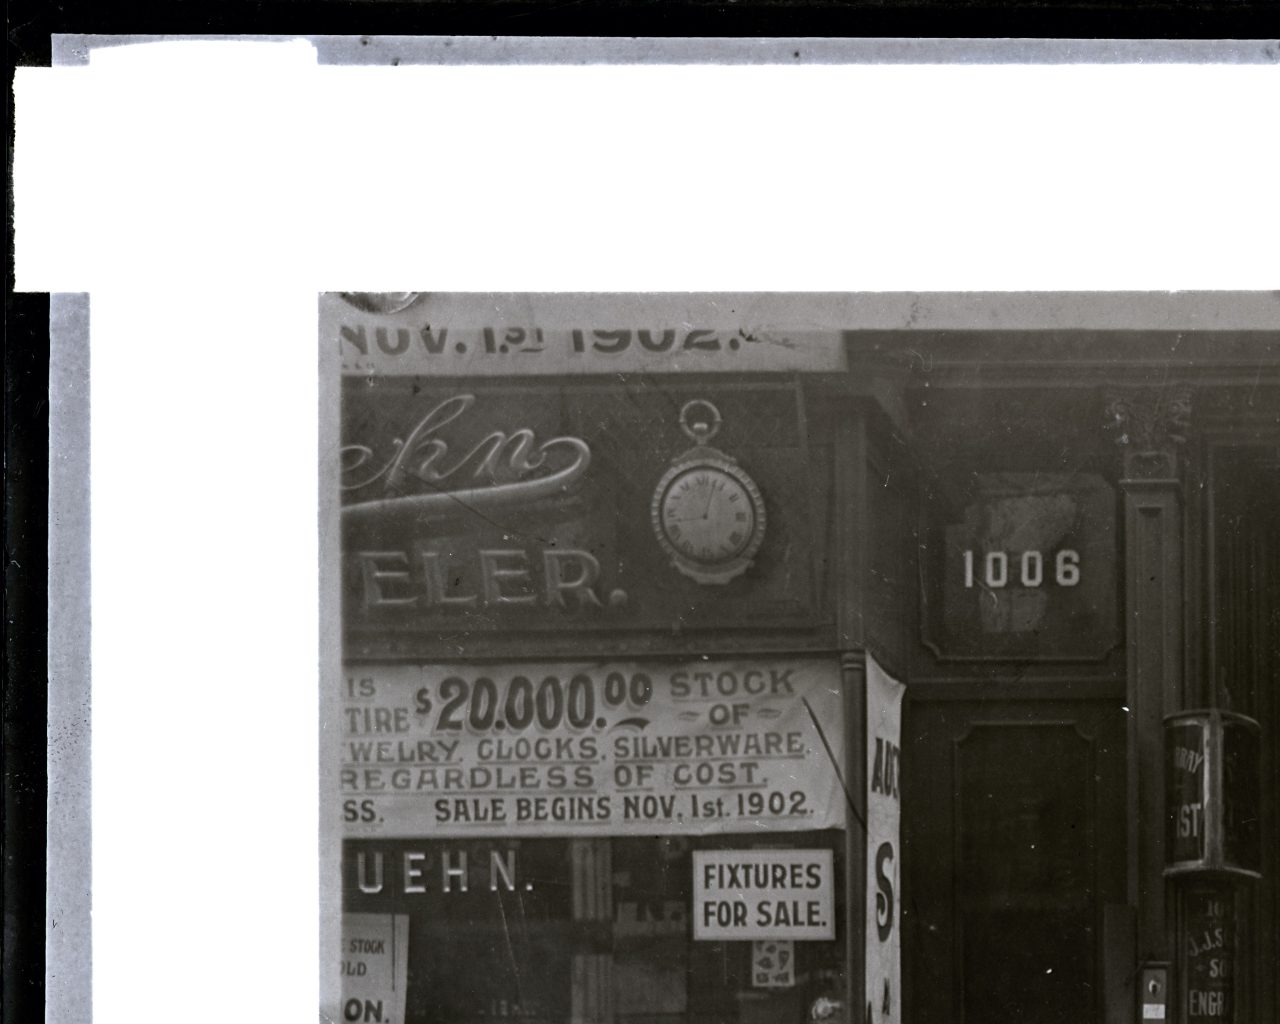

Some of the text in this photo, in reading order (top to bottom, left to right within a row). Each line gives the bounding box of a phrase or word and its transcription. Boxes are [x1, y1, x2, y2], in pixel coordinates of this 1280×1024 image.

[963, 548, 1082, 588] 1006
[670, 670, 796, 696] STOCK
[709, 703, 752, 727] OF
[615, 764, 655, 787] OF
[673, 762, 768, 786] COST.
[435, 800, 508, 824] SALE
[516, 797, 612, 822] BEGINS
[623, 796, 683, 820] NOV.
[737, 791, 815, 817] 1902.
[703, 862, 822, 890] FIXTURES
[703, 901, 828, 928] FOR SALE.
